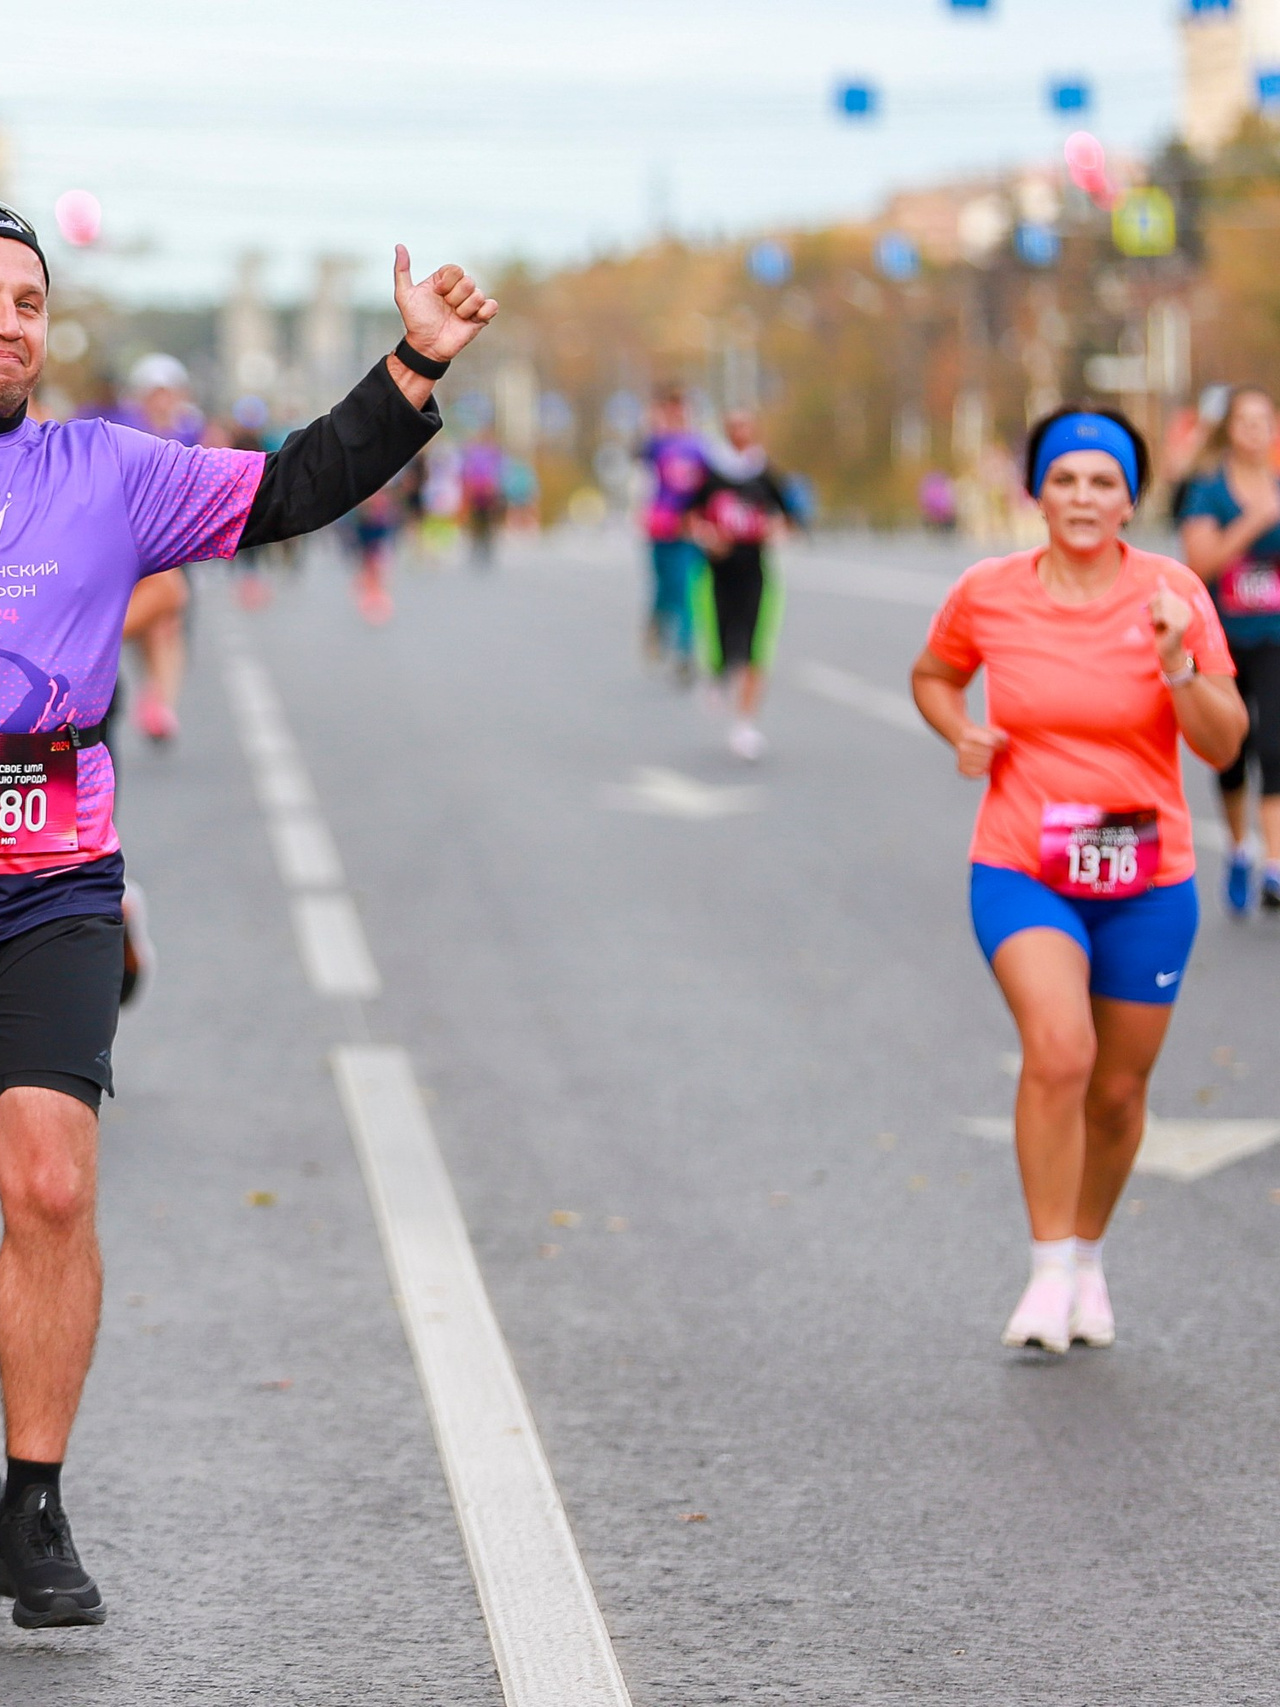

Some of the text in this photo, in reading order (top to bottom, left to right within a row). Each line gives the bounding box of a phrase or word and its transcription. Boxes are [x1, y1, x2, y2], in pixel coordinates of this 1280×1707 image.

[51, 741, 70, 752] 2024
[24, 764, 43, 773] ИМЯ
[14, 775, 47, 784] ГОРОДА
[1066, 844, 1138, 885] 1376
